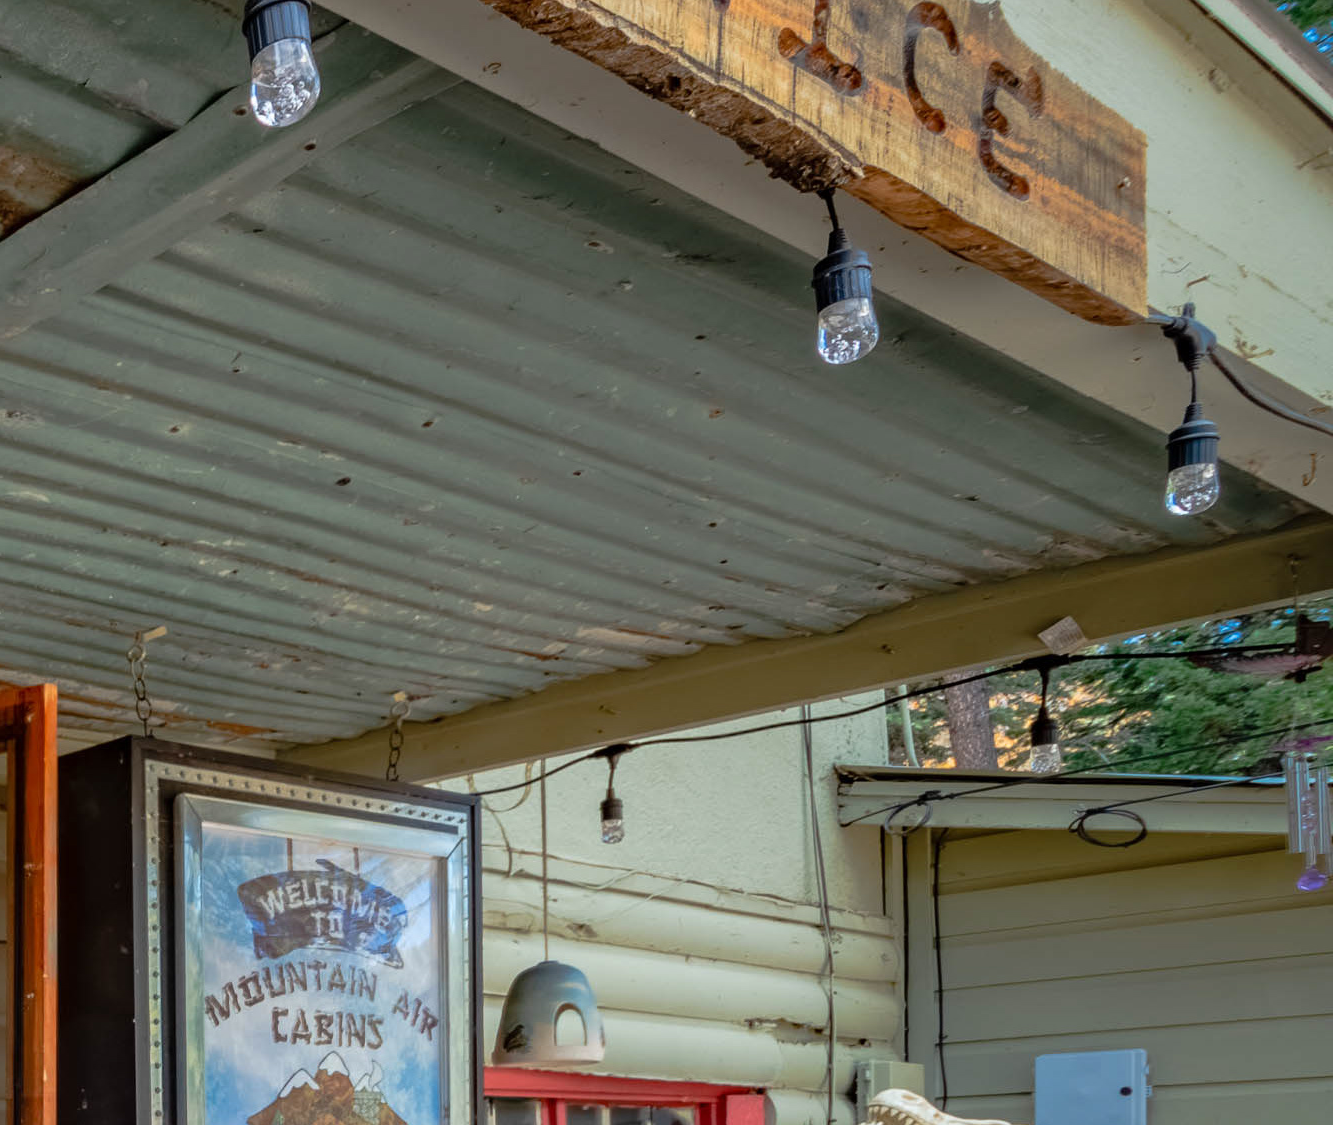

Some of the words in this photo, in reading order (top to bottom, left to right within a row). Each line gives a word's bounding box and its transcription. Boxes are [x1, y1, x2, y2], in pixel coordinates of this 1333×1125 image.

[259, 878, 391, 928] WELCOME
[310, 910, 344, 938] TO
[205, 959, 377, 1027] MOUNTAIN
[392, 988, 438, 1041] AIR
[272, 1007, 384, 1050] CABINS
